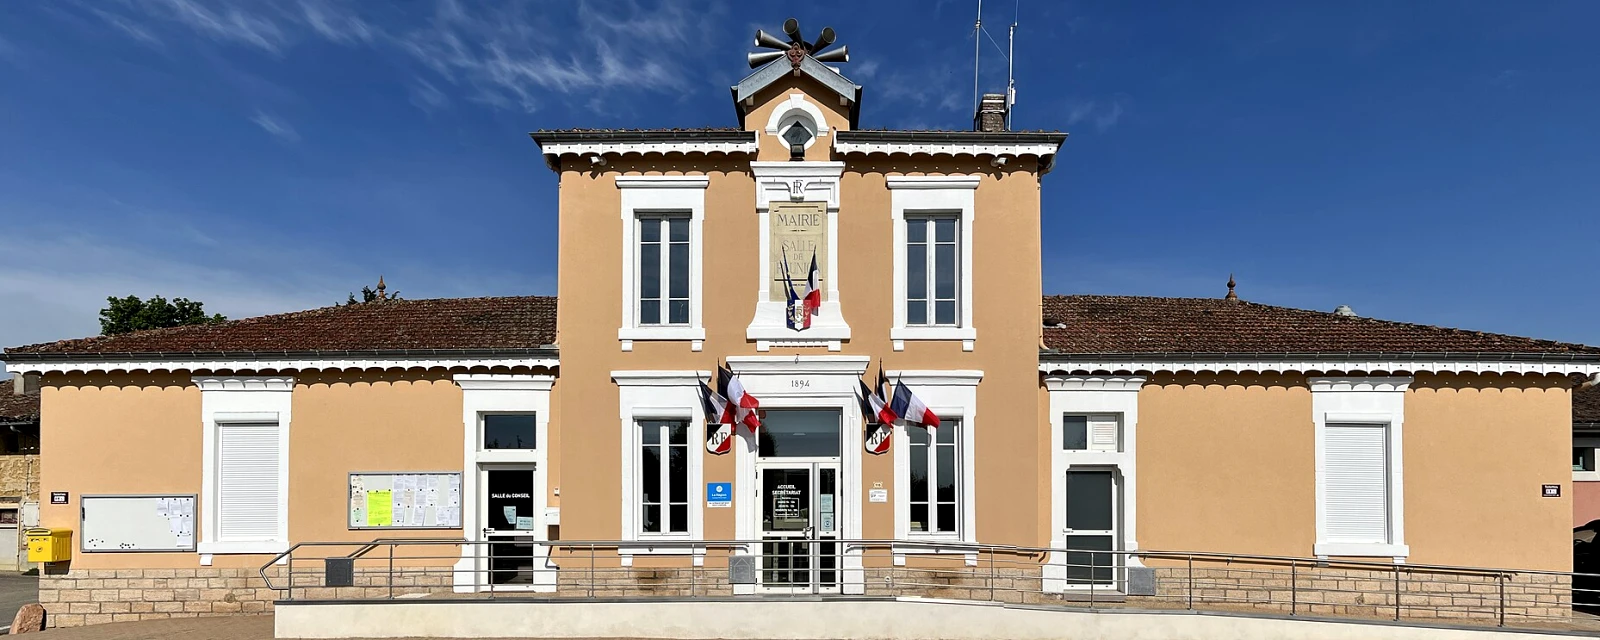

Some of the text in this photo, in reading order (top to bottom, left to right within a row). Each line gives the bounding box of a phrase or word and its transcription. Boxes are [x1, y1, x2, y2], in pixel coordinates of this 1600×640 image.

[777, 213, 820, 227] MAIRIE
[783, 240, 815, 252] SALLE
[793, 253, 804, 261] DE
[791, 379, 810, 389] 1894
[711, 431, 728, 445] RF
[870, 431, 887, 445] RF
